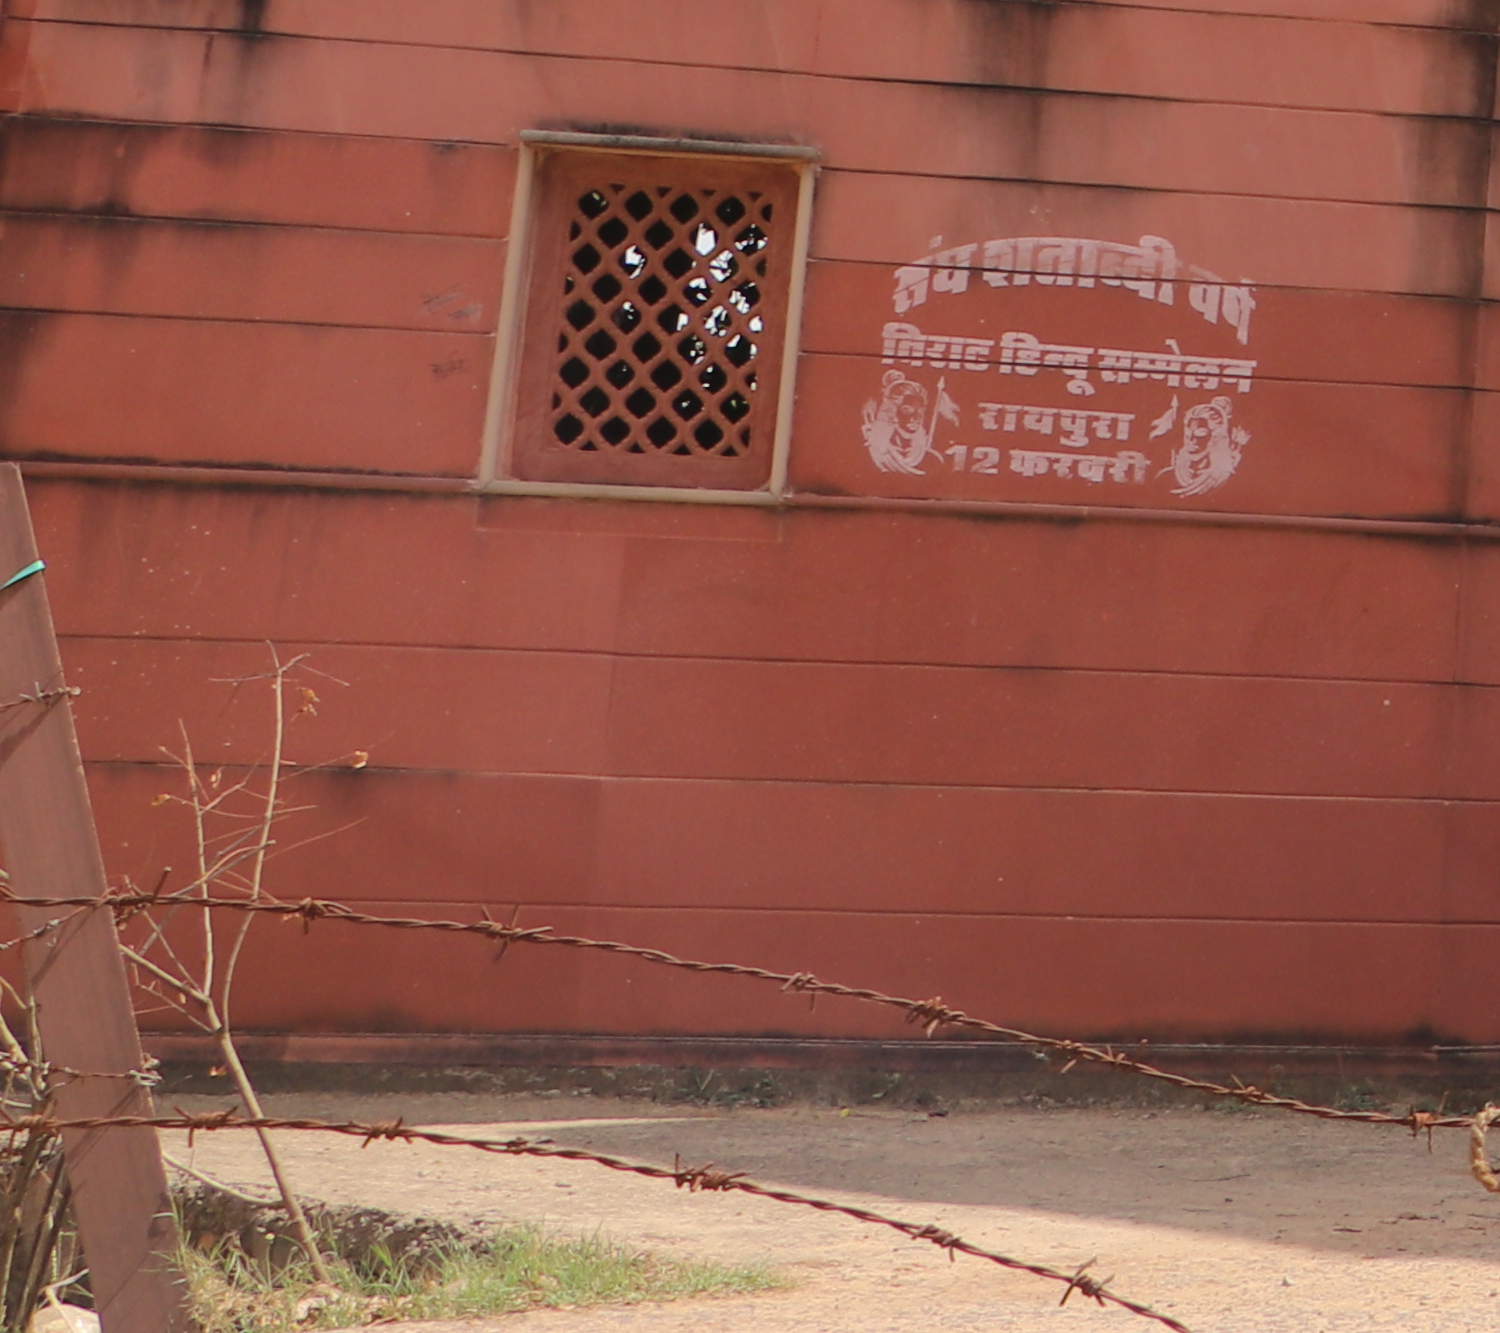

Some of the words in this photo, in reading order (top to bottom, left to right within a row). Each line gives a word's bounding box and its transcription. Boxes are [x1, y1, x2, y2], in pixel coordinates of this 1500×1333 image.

[999, 332, 1096, 396] हिन्दू
[1098, 339, 1258, 393] सम्मेलन
[978, 402, 1136, 448] रायपुरा
[945, 445, 1000, 475] 12
